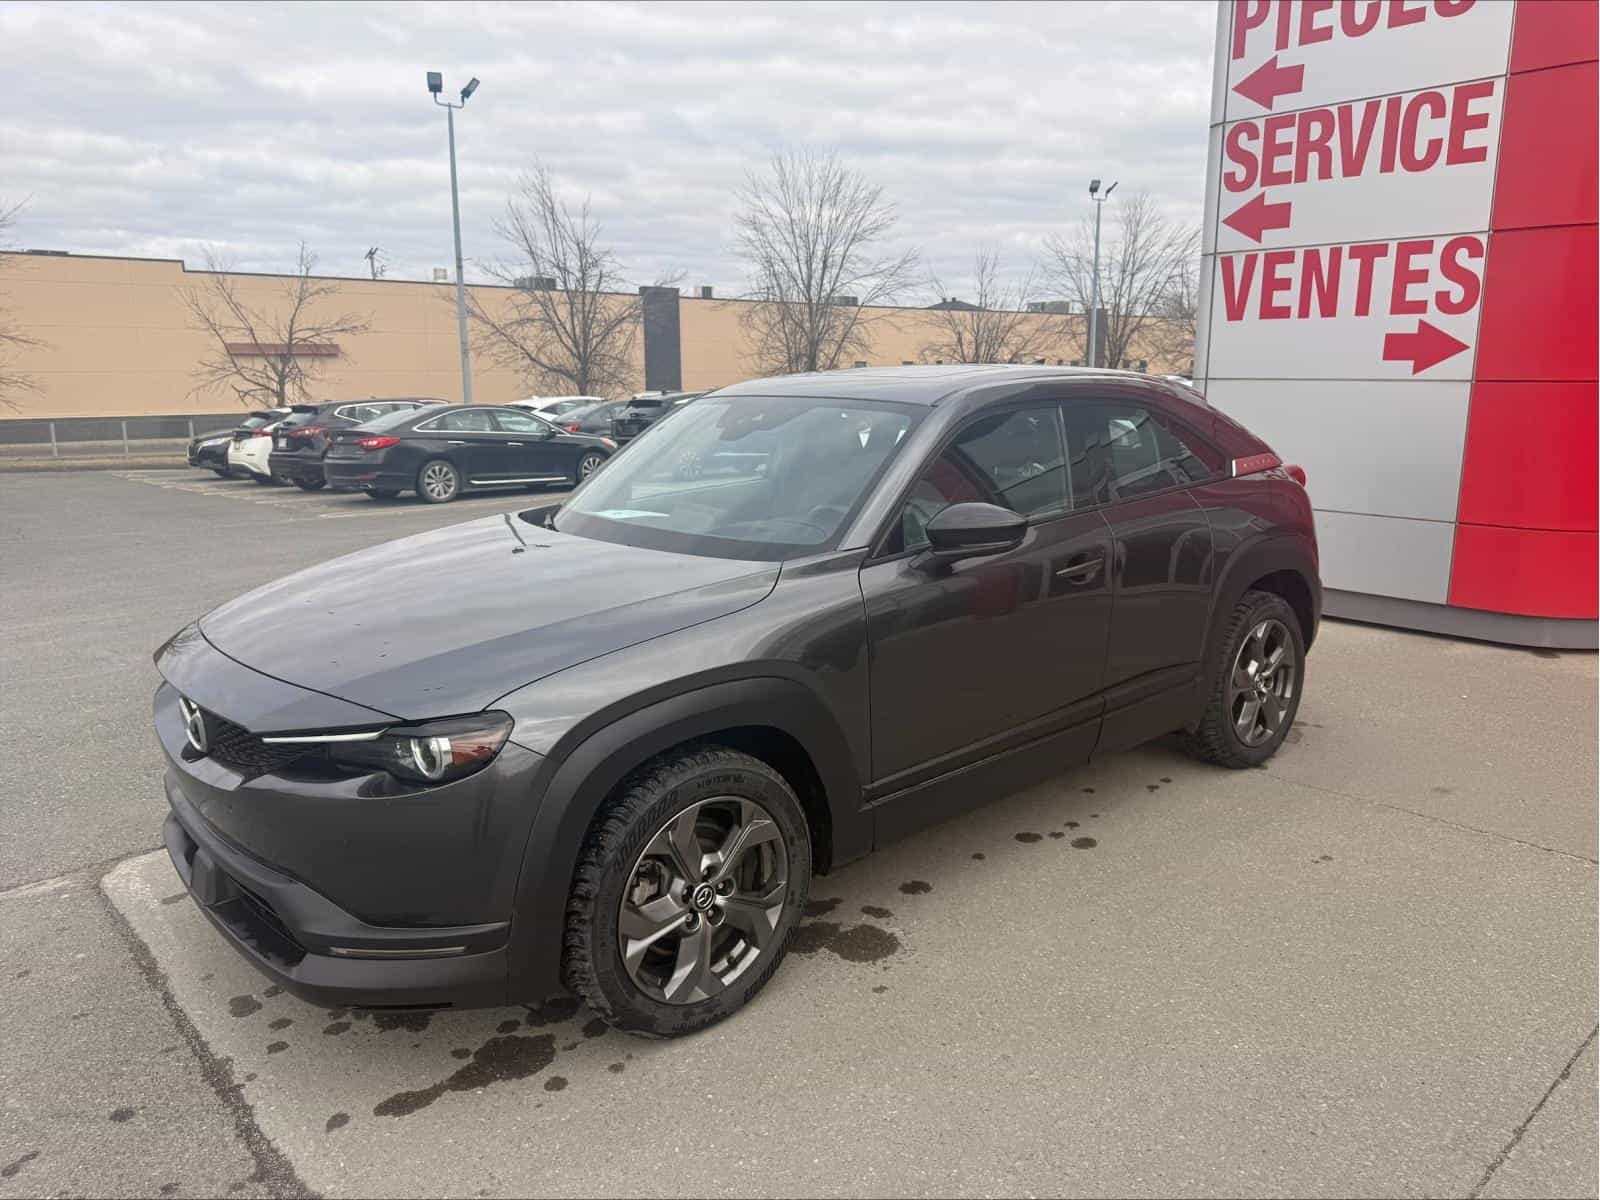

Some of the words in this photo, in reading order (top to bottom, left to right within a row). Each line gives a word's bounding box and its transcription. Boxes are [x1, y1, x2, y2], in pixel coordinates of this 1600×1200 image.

[1232, 0, 1477, 60] PIE
[1223, 80, 1495, 192] SERVICE
[1220, 235, 1484, 321] VENTES
